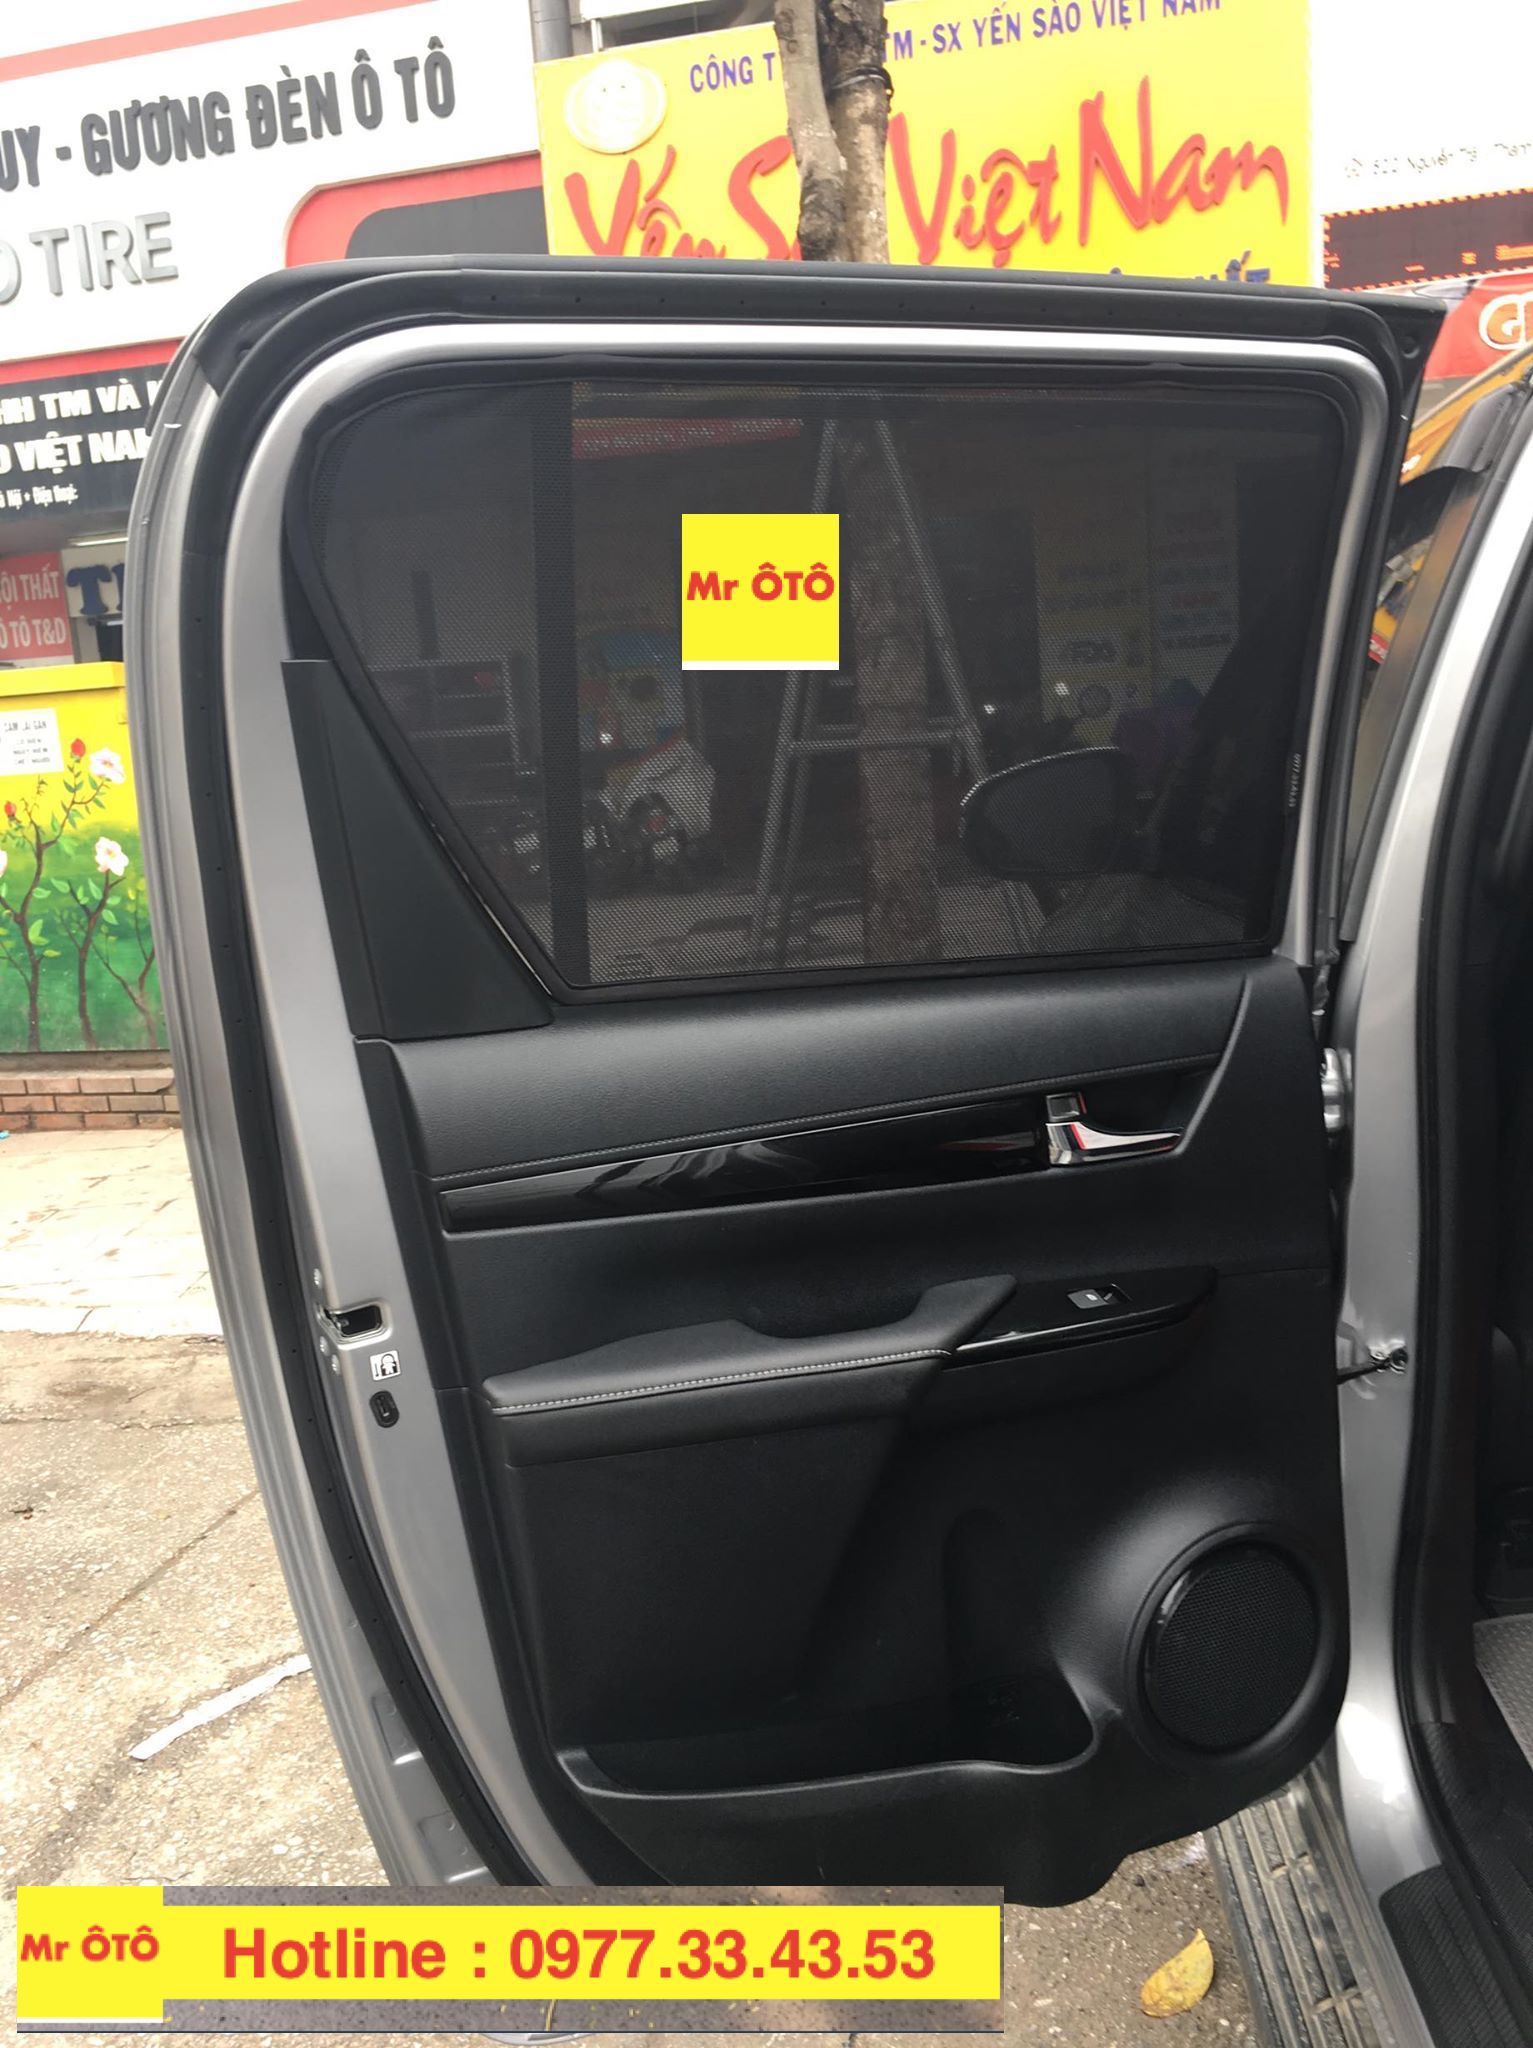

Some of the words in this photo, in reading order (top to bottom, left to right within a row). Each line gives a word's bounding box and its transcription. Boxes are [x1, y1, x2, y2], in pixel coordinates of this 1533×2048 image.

[690, 54, 754, 94] CÔNG
[81, 91, 236, 176] GƯƠNG
[245, 65, 343, 150] ĐÈN
[351, 48, 384, 130] Ô
[394, 36, 456, 123] TÔ
[887, 112, 1062, 268] Việt
[1079, 75, 1290, 247] Nam
[29, 211, 179, 297] TIRE
[39, 389, 92, 420] TM
[96, 378, 142, 413] VÀ
[13, 431, 83, 474] VIỆT
[32, 617, 66, 646] T&D
